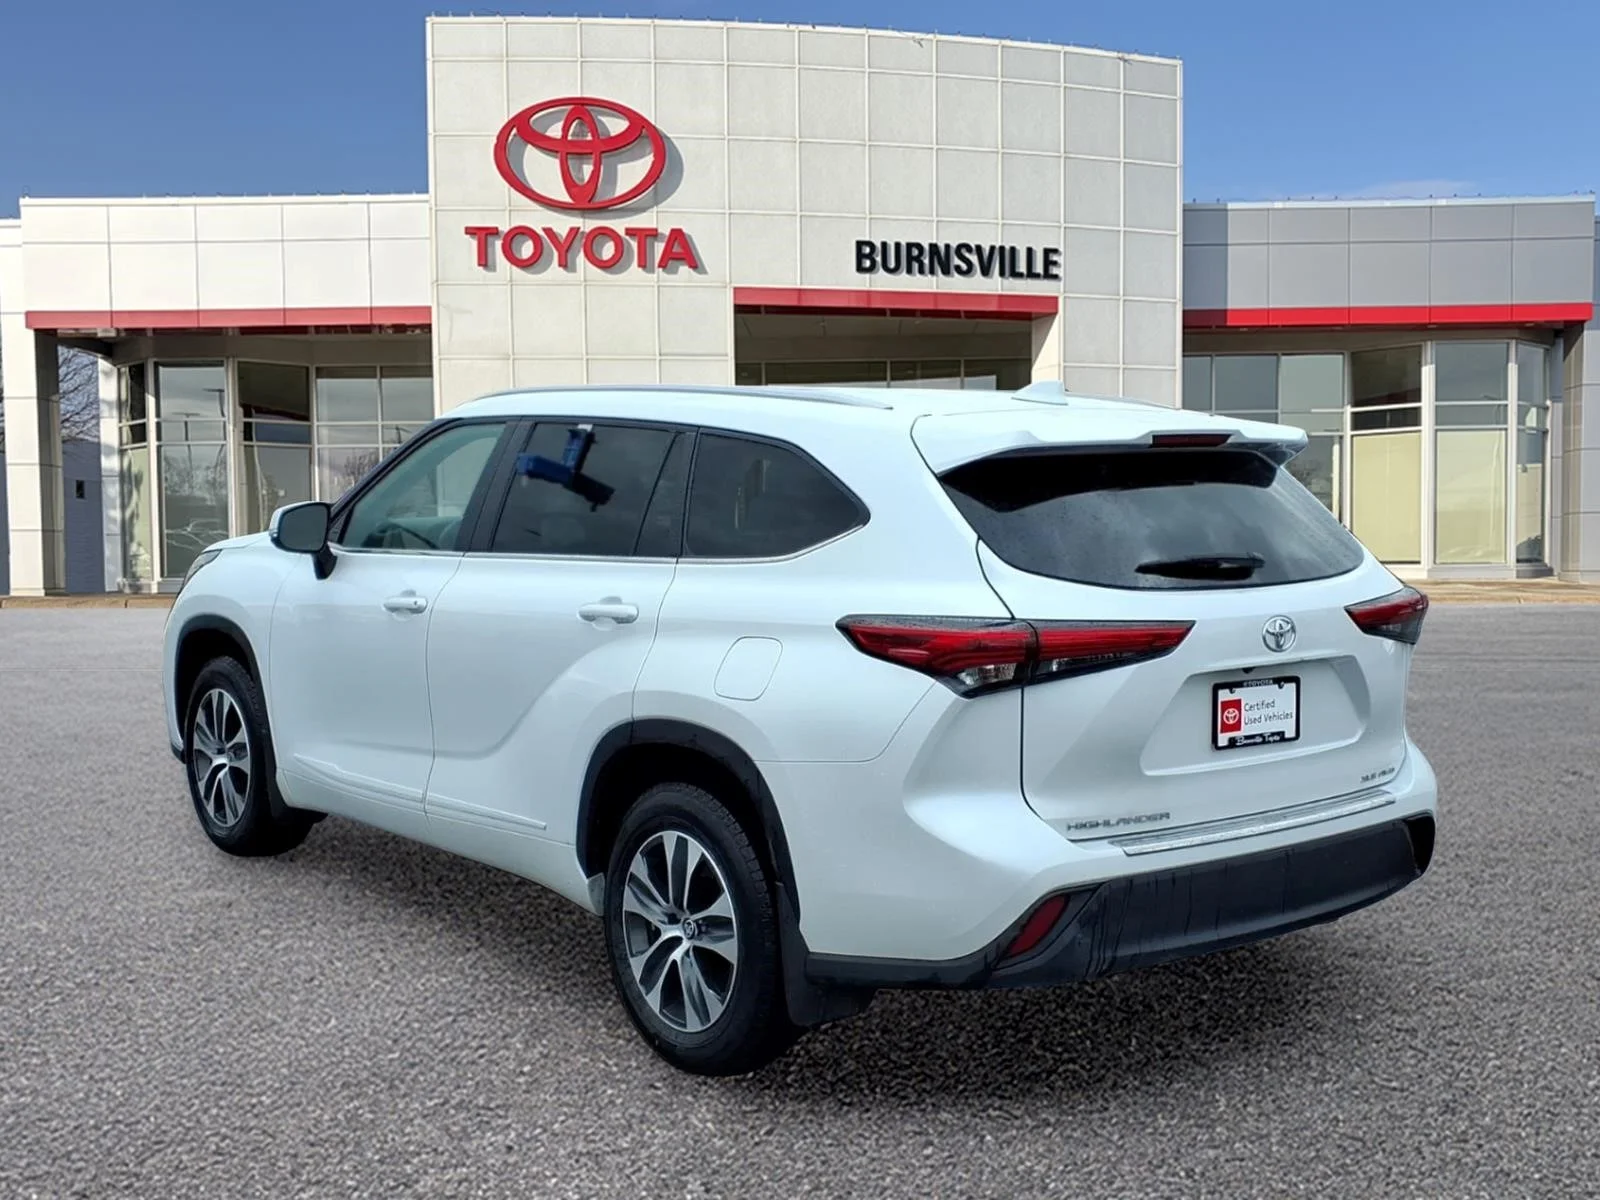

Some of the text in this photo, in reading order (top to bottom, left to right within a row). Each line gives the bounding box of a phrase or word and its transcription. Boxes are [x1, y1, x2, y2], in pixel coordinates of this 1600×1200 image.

[464, 225, 699, 270] TOYOTA
[855, 240, 1061, 280] BURNSVILLE
[1244, 699, 1275, 712] Certified
[1244, 711, 1293, 725] Used Vehicles
[1067, 812, 1170, 831] HIGHLANDER
